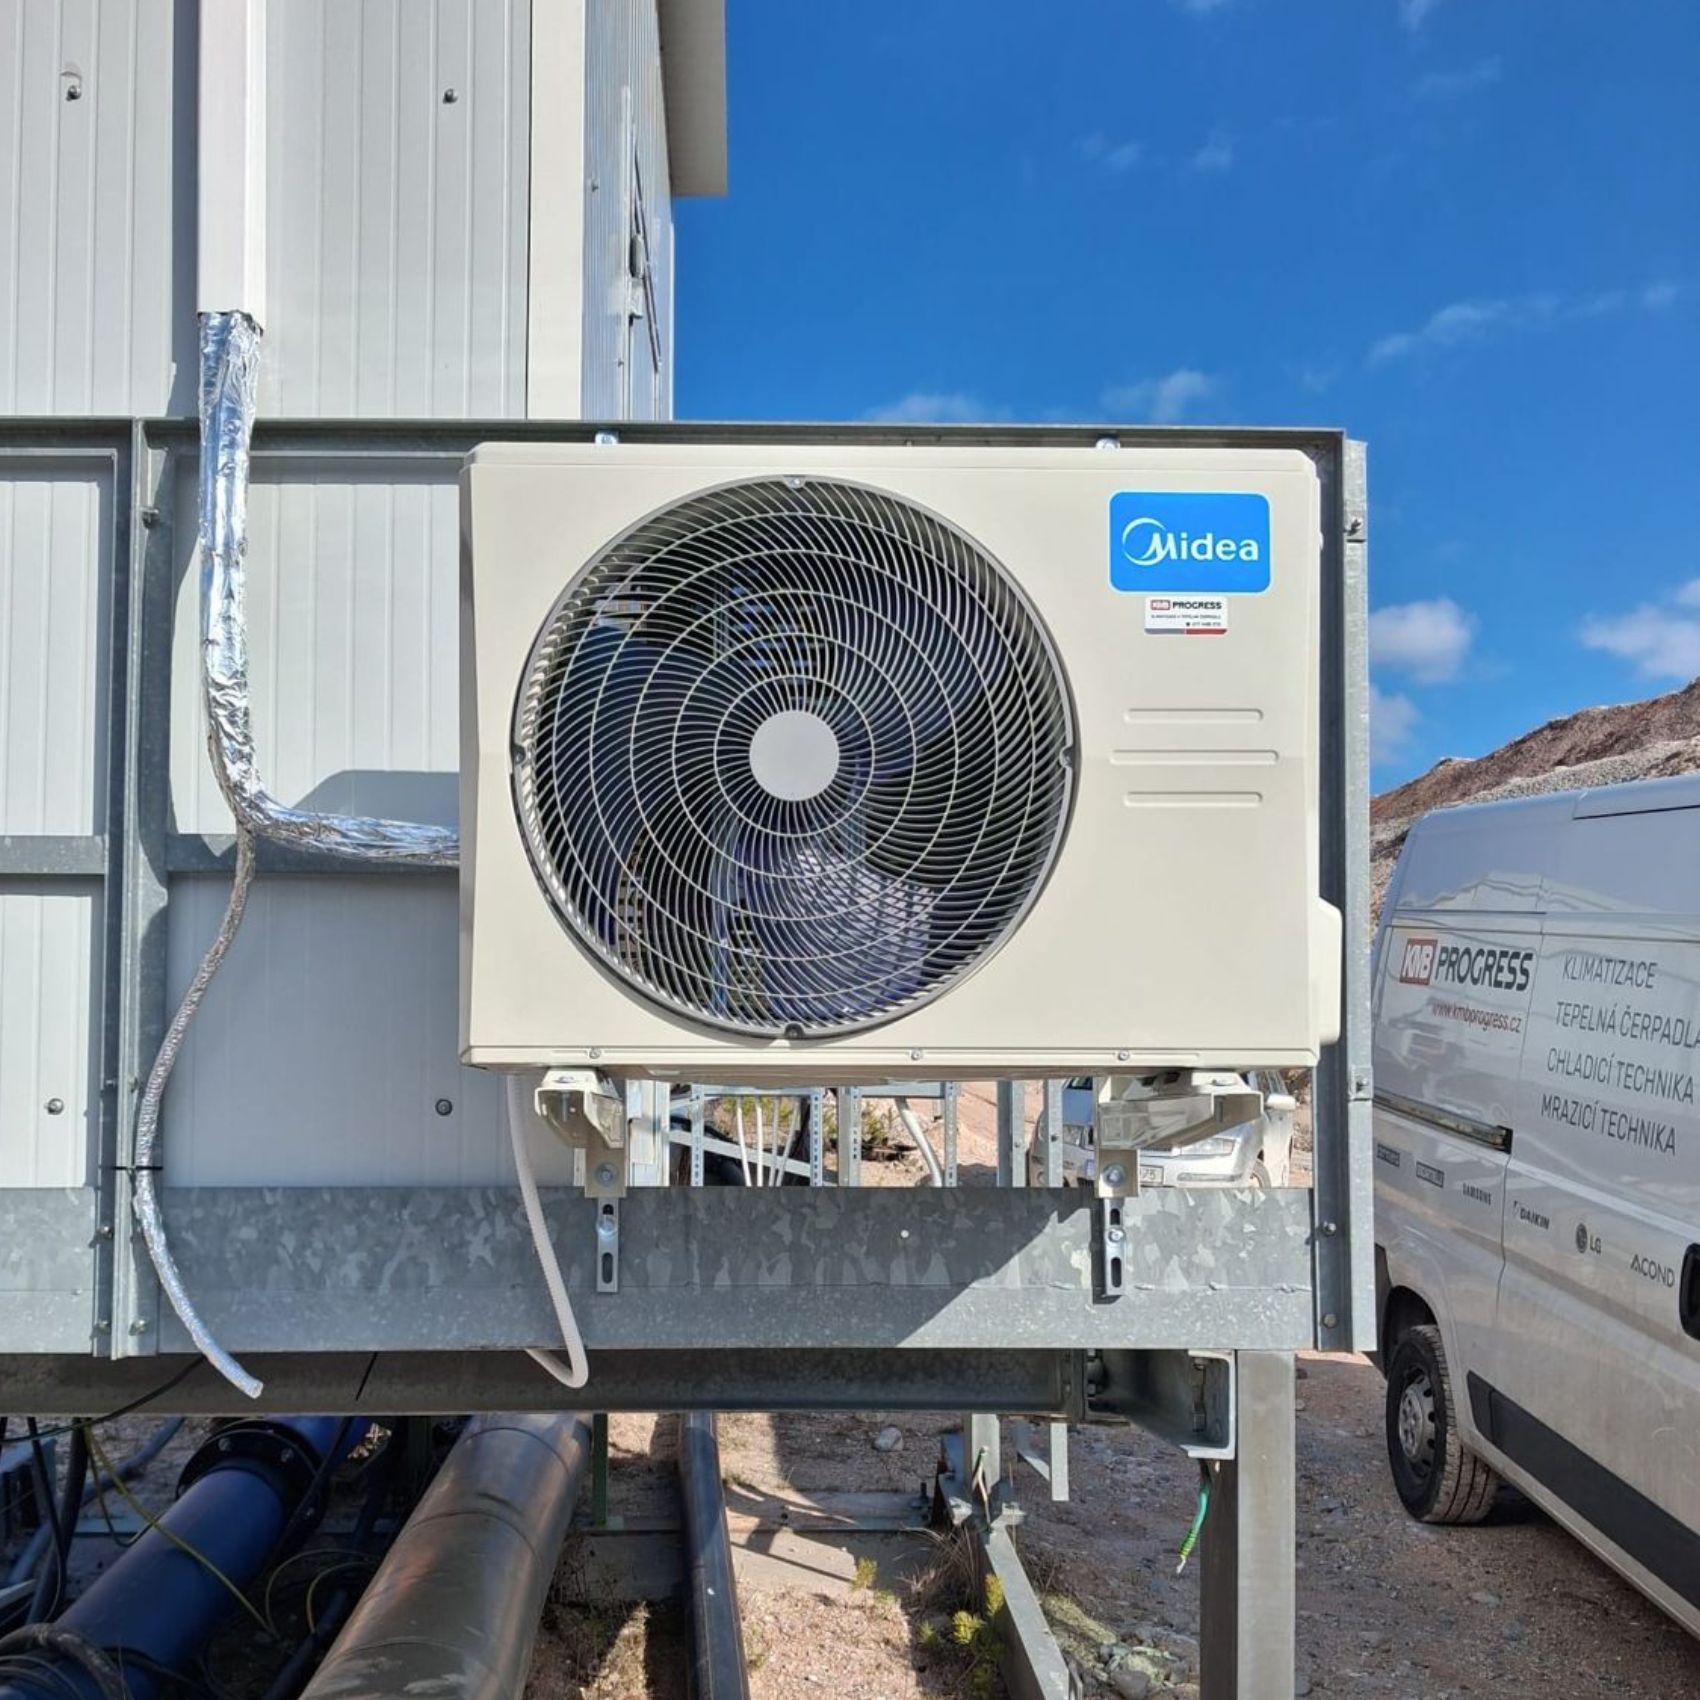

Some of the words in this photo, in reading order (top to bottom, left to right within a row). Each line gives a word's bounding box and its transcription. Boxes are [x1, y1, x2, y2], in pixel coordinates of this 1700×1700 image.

[1122, 517, 1259, 566] Midea
[1172, 601, 1222, 610] PROGRESS
[1435, 946, 1533, 991] PROGRESS
[1562, 955, 1658, 989] KLIMATIZACE
[1556, 1001, 1618, 1034] TEPELNÁ
[1547, 1047, 1615, 1084] CHLADICÍ
[1616, 1061, 1694, 1105] TECHNIKA
[1541, 1094, 1599, 1131] MRAZICÍ
[1600, 1108, 1676, 1155] TECHNIKA
[1520, 1207, 1550, 1230] DAIKIN
[1589, 1235, 1602, 1254] LG
[1630, 1254, 1675, 1287] ACOND
